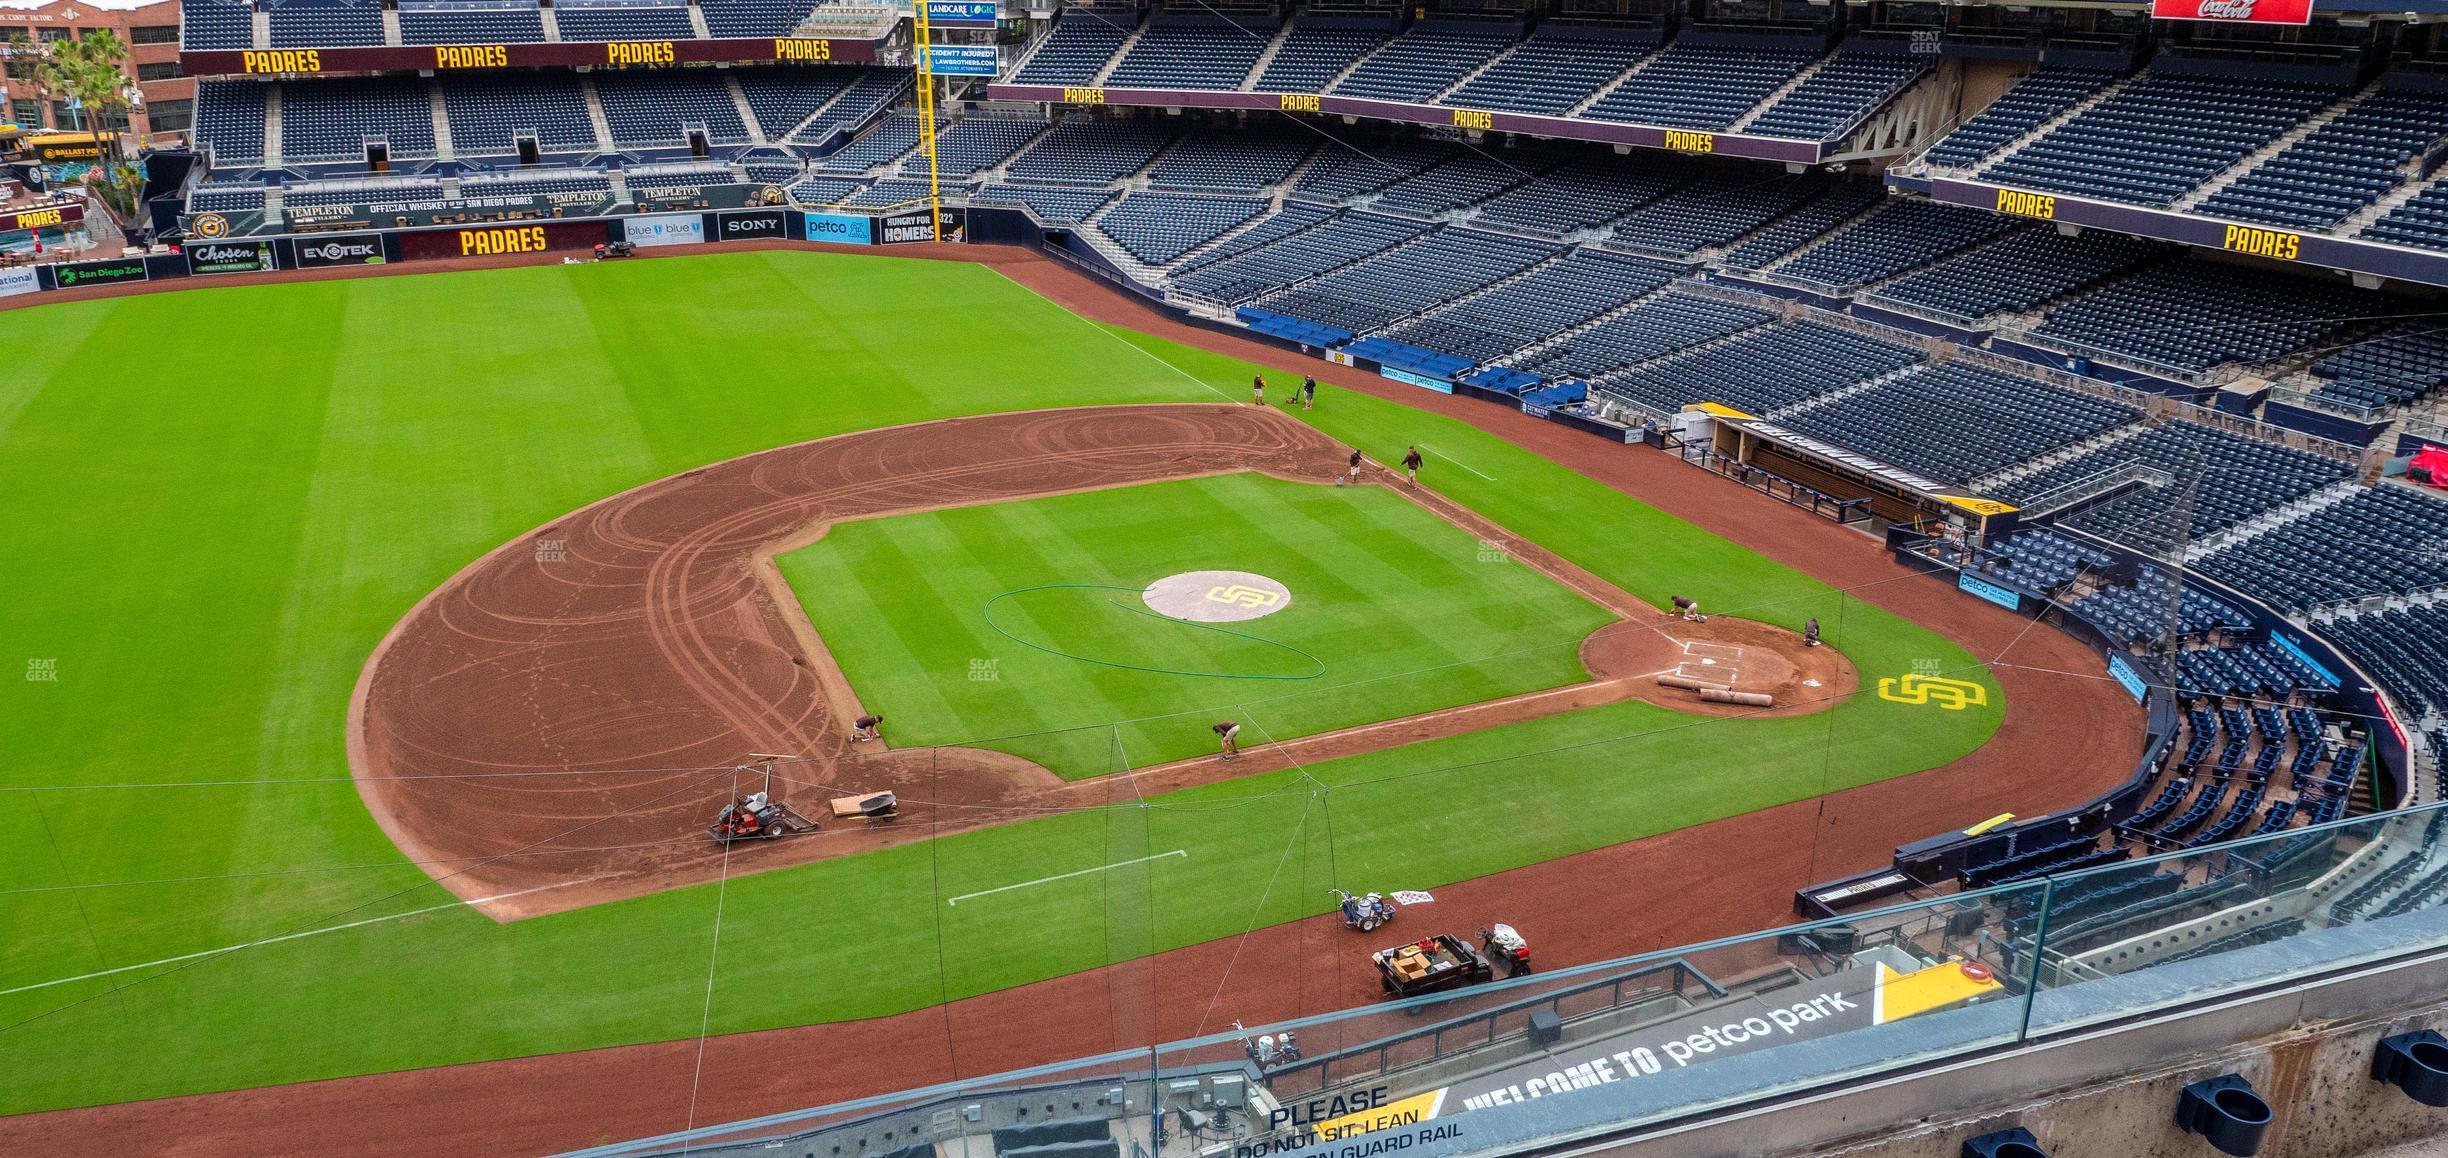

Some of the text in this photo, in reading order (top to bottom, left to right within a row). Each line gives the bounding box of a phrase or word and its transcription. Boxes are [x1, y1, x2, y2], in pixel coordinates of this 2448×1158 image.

[930, 5, 994, 14] LANDCARE LOGIC
[436, 46, 508, 68] PADRES
[608, 42, 674, 64] PADRES
[776, 40, 829, 60] PADRES
[962, 50, 994, 58] INJURED?
[243, 50, 320, 73] PADRES
[1064, 88, 1104, 104] PADRES
[1281, 94, 1320, 112] PADRES
[1454, 110, 1492, 128] PADRES
[1665, 130, 1713, 152] PADRES
[55, 148, 108, 156] BALLAST POIT
[546, 192, 606, 204] TEMPLETON
[643, 187, 700, 198] TEMPLETON
[288, 206, 354, 218] TEMPLETON
[370, 203, 408, 213] OFFICIAL
[409, 202, 447, 211] WHISKEY
[466, 200, 482, 208] SAN
[484, 198, 504, 207] DIEGO
[506, 196, 534, 206] PADRES
[1996, 189, 2054, 220] PADRES
[16, 209, 62, 230] PADRES
[728, 219, 778, 232] SONY
[886, 216, 930, 226] HUNGRY FOR
[940, 212, 954, 224] 322
[628, 226, 652, 236] blue
[666, 224, 690, 232] blue
[809, 219, 847, 234] petco
[884, 226, 934, 242] HOMERS
[460, 226, 547, 256] PADRES
[2224, 225, 2300, 260] PADRES
[196, 246, 254, 261] Chosen
[304, 243, 375, 260] EVOTEK
[0, 272, 32, 286] ational
[79, 266, 143, 279] San Diego Zoo
[1382, 368, 1398, 378] petco
[1417, 378, 1434, 387] petco
[1961, 577, 1988, 593] petco
[2112, 660, 2128, 680] petco
[1616, 1046, 1663, 1078] TO
[1660, 1017, 1773, 1067] petco
[1768, 992, 1858, 1034] park
[1270, 1086, 1388, 1131] PLEASE
[1238, 1109, 1420, 1158] DO NOT SIT, LEAN
[1340, 1132, 1413, 1158] GUARD
[1419, 1123, 1463, 1145] RAIL
